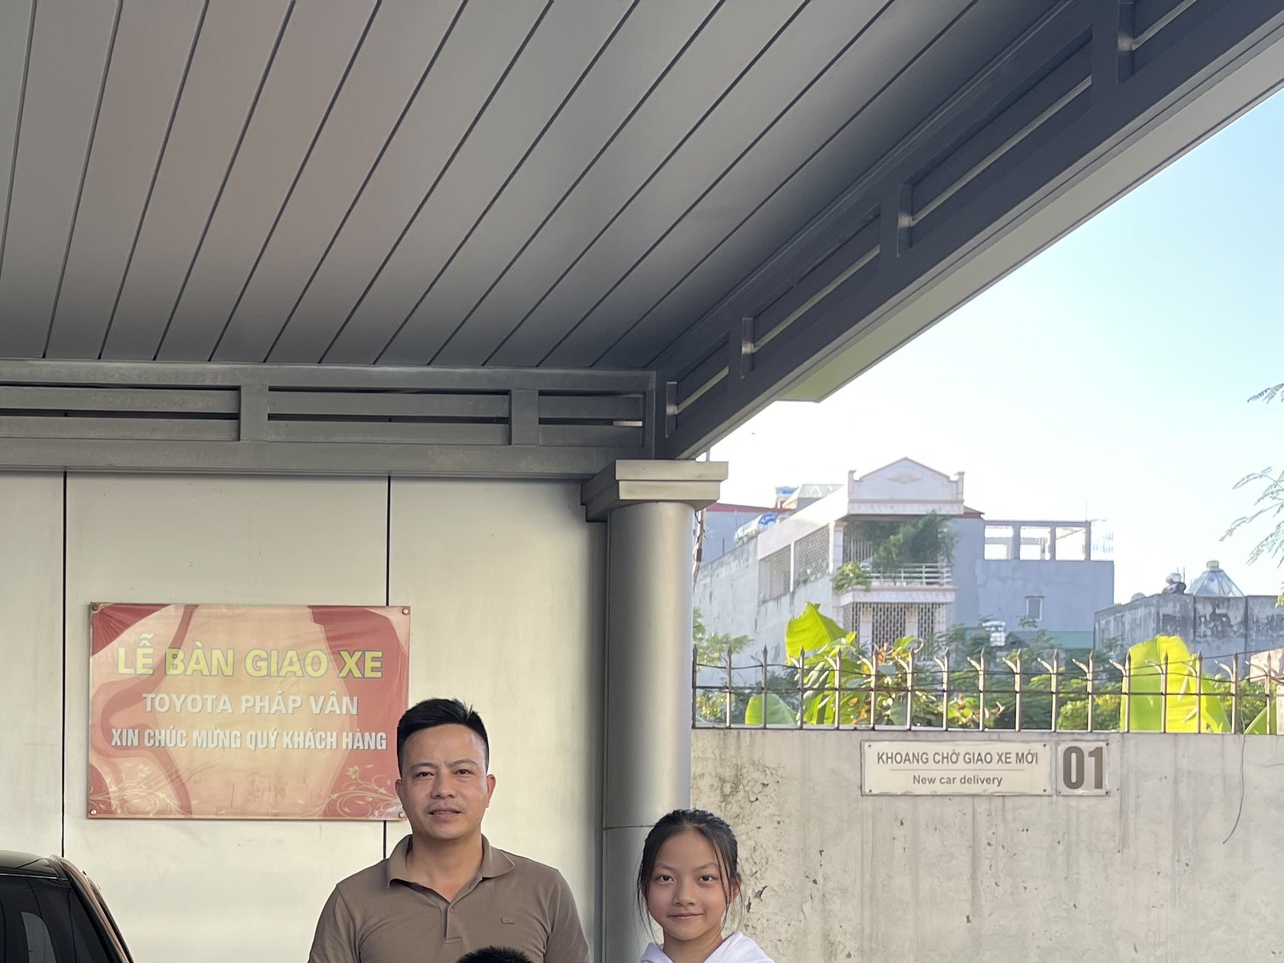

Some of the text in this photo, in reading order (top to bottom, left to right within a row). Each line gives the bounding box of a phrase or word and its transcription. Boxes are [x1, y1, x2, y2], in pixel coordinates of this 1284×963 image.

[117, 633, 383, 679] LỄ BÀN GIAO XE
[142, 691, 359, 715] TOYOTA PHÁP VÂN
[111, 728, 139, 747] XIN
[144, 726, 188, 748] CHÚC
[247, 728, 278, 751] QUÝ
[283, 728, 337, 750] KHÁCH
[342, 728, 388, 751] HÀNG
[877, 749, 1038, 765] KHOANG CHỜ GIAO XE MỚI
[1063, 745, 1104, 790] 01
[912, 774, 1003, 787] New car delivery
